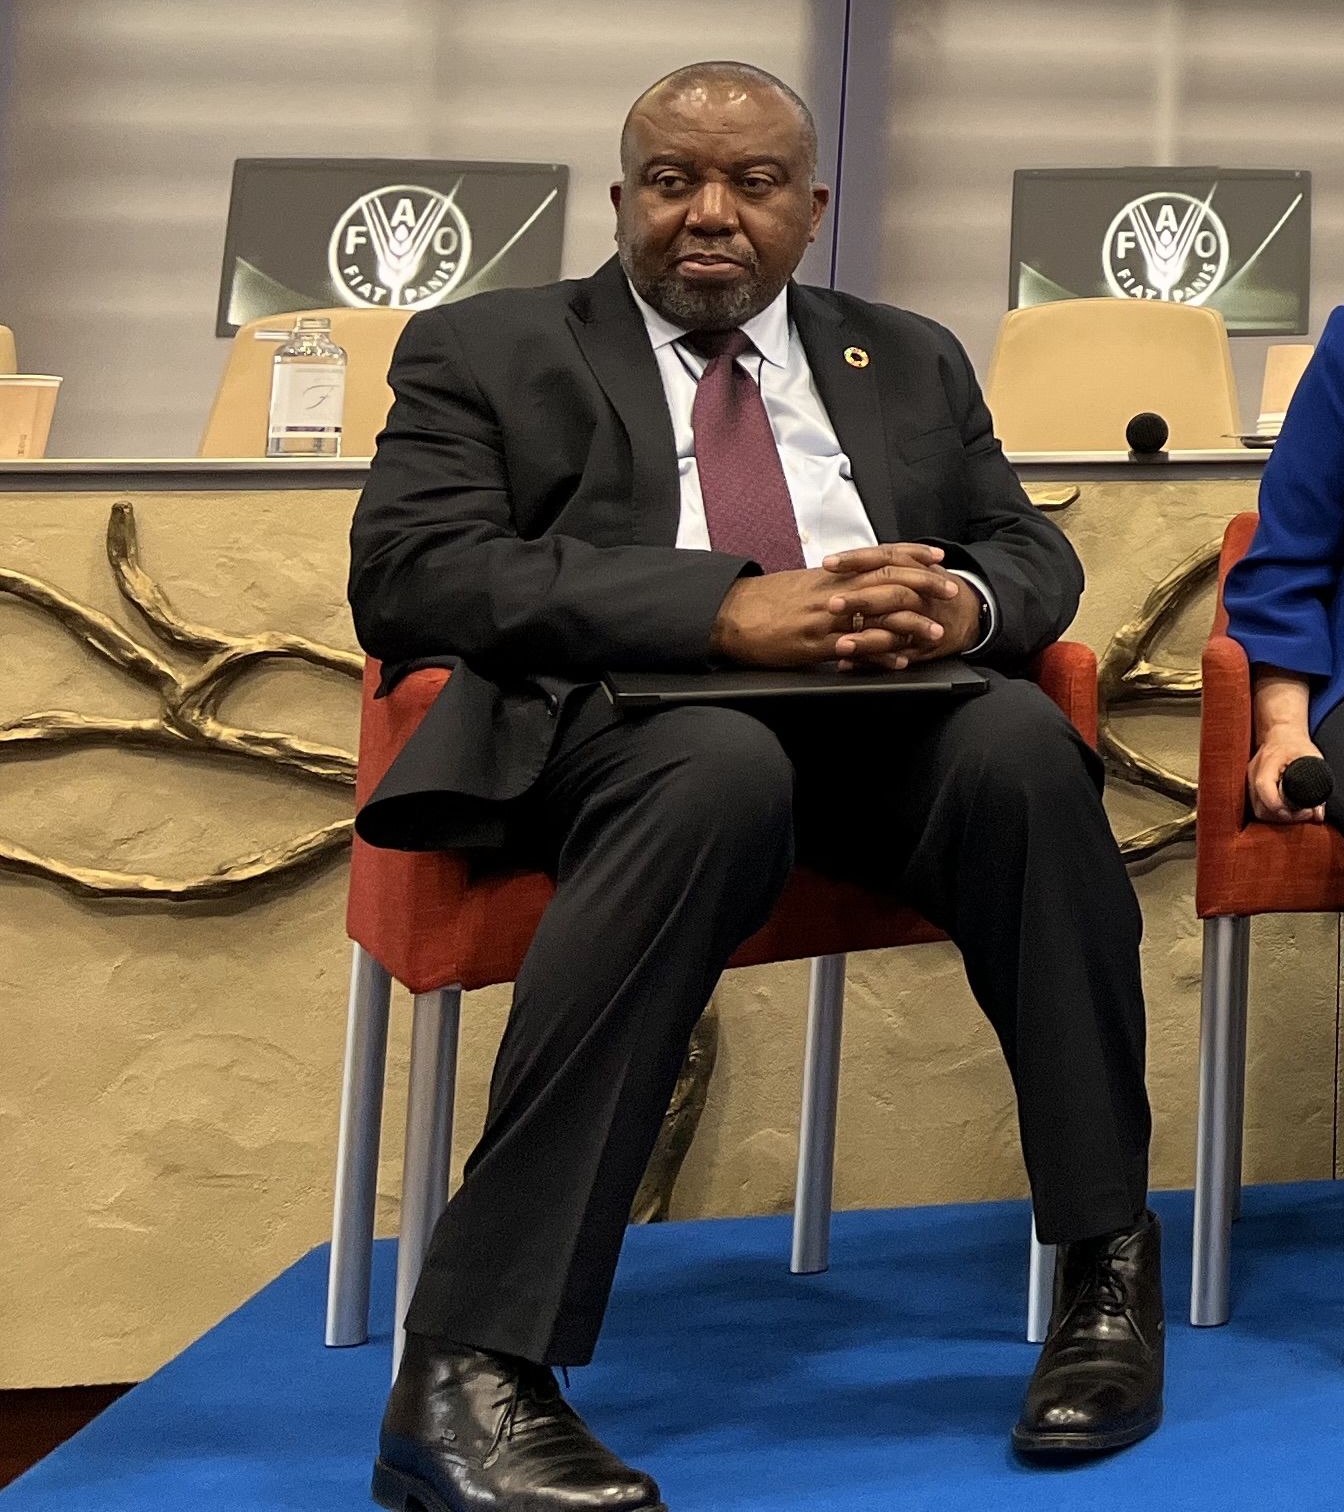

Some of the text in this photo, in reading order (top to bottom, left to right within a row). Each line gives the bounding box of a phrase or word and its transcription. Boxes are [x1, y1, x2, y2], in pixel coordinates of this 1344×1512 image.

[345, 198, 458, 256] FAO
[1116, 204, 1217, 259] FAO
[343, 260, 456, 304] FIAT PANIS
[1117, 263, 1217, 303] FIAT PANIS
